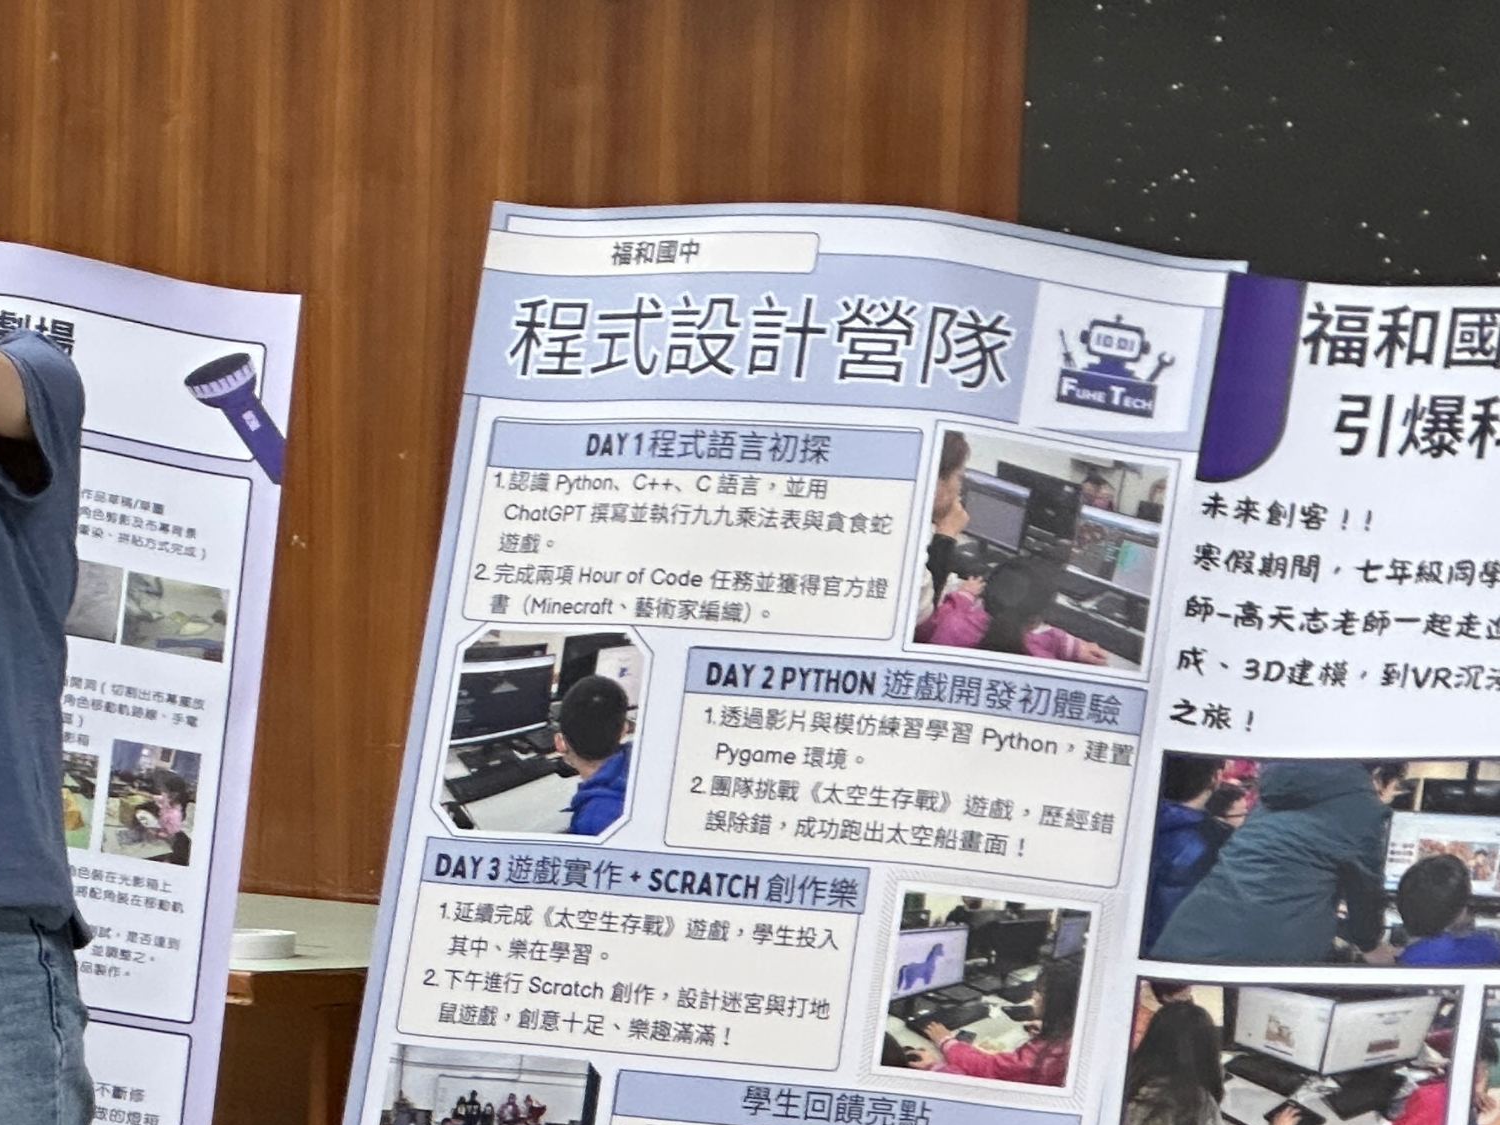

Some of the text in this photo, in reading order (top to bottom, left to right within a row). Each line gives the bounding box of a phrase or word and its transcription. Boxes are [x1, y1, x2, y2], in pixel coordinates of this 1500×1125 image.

[611, 239, 701, 266] 福和國中
[508, 296, 1012, 388] 程式設計營隊
[1303, 301, 1500, 369] 福和國
[504, 502, 894, 536] ChatGPT 撰寫並執行九九乘法表與貪食蛇
[579, 567, 619, 585] Hour
[627, 567, 645, 585] of
[650, 569, 703, 588] Code
[706, 662, 756, 689] DAY
[716, 742, 797, 768] Pygame
[435, 853, 485, 880] DAY
[649, 871, 759, 900] SCRATCH
[529, 977, 604, 1001] Scratch
